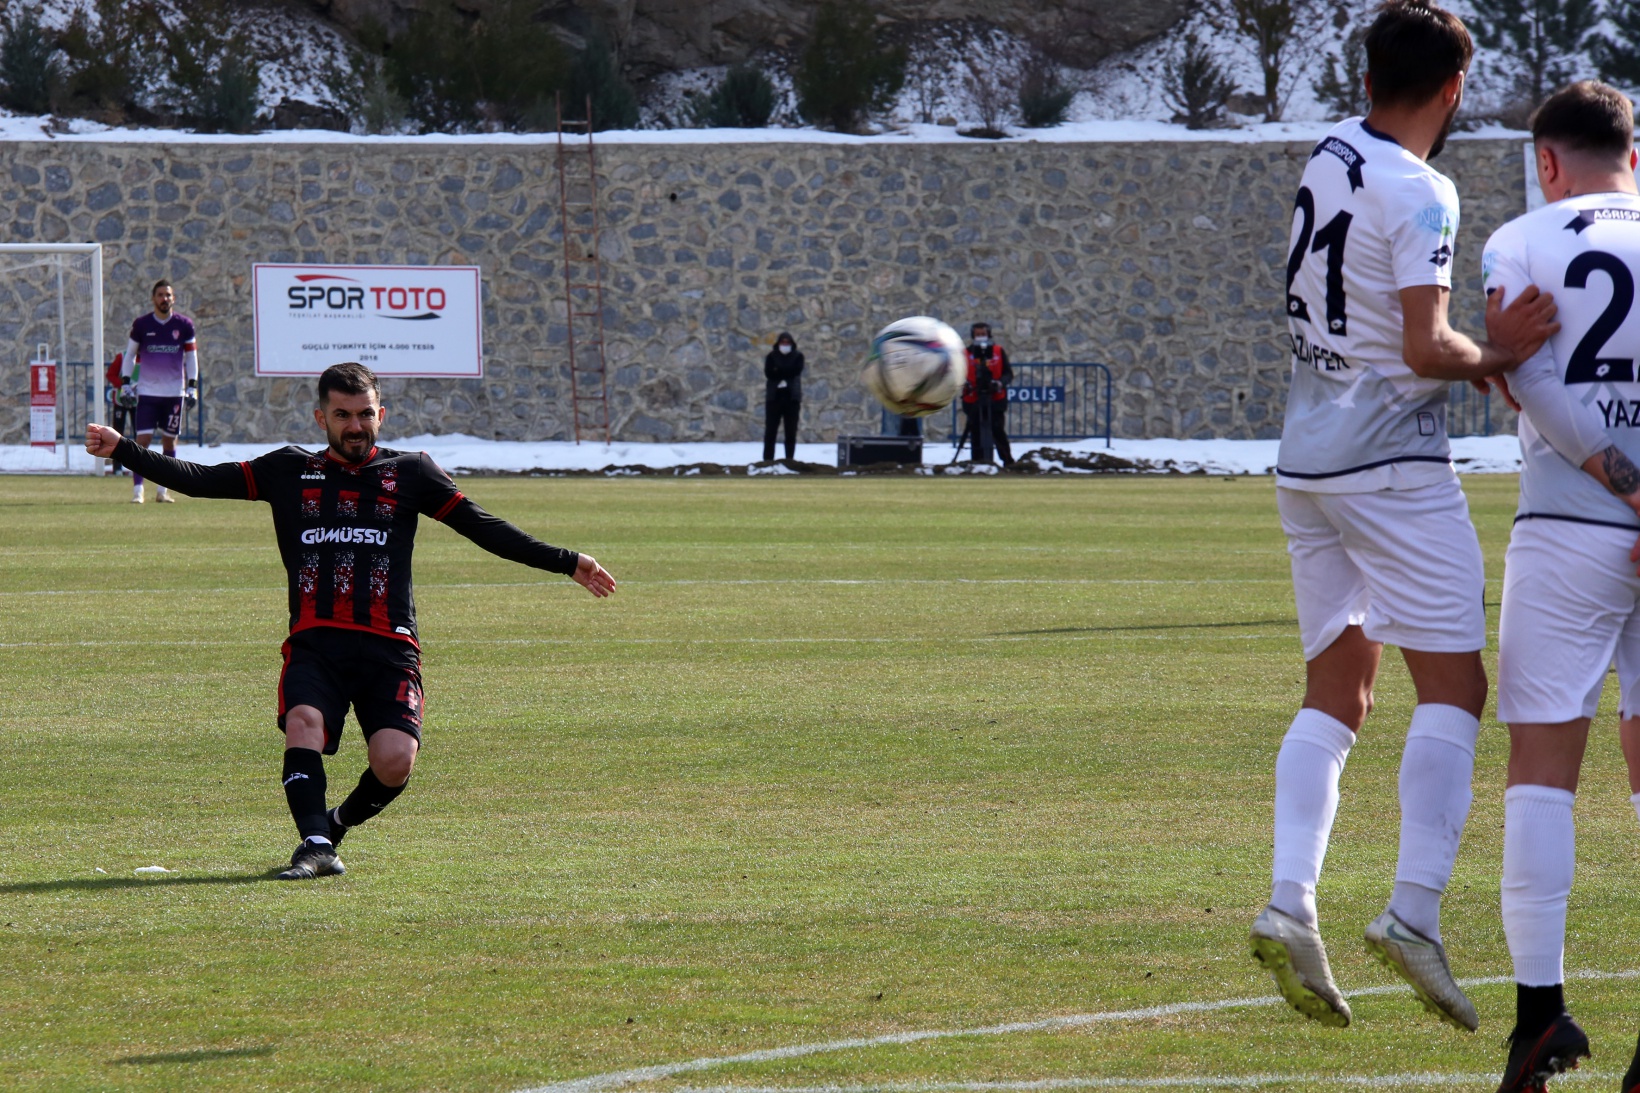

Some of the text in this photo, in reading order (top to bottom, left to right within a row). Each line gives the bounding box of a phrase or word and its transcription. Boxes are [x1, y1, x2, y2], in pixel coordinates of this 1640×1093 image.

[1286, 185, 1354, 337] 21
[288, 286, 446, 310] SPOR TOTO
[302, 343, 330, 351] GÜÇLÜ
[332, 342, 367, 350] TÜRKİYE
[369, 342, 386, 351] İÇİN
[412, 343, 435, 351] TESİS
[1007, 384, 1057, 401] POLİS
[167, 414, 180, 429] 13
[301, 526, 388, 546] GÜMÜŞSU
